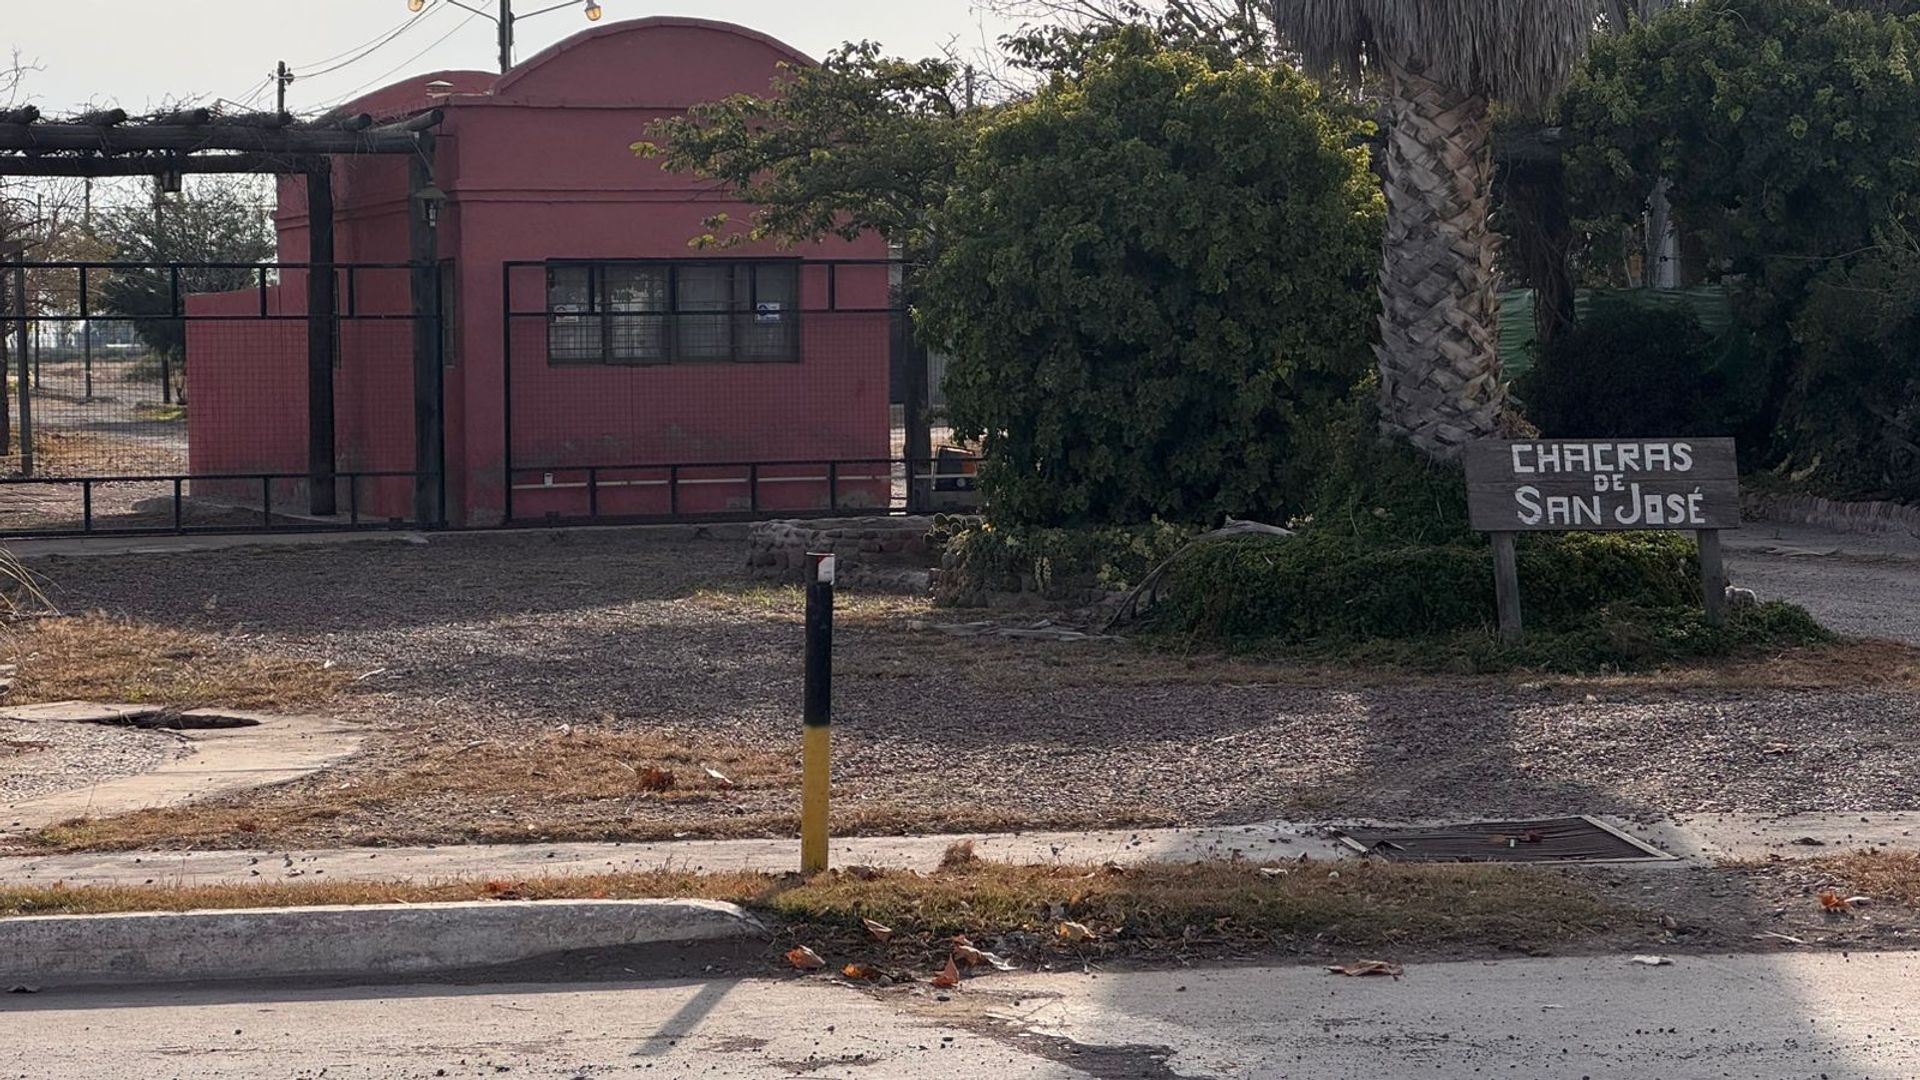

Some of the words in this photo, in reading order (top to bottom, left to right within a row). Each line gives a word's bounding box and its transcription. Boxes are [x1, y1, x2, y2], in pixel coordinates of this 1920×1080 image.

[1511, 442, 1693, 473] CHACRAS
[1594, 474, 1625, 492] DE
[1514, 485, 1601, 525] SAN
[1614, 482, 1706, 525] JOSÉ
